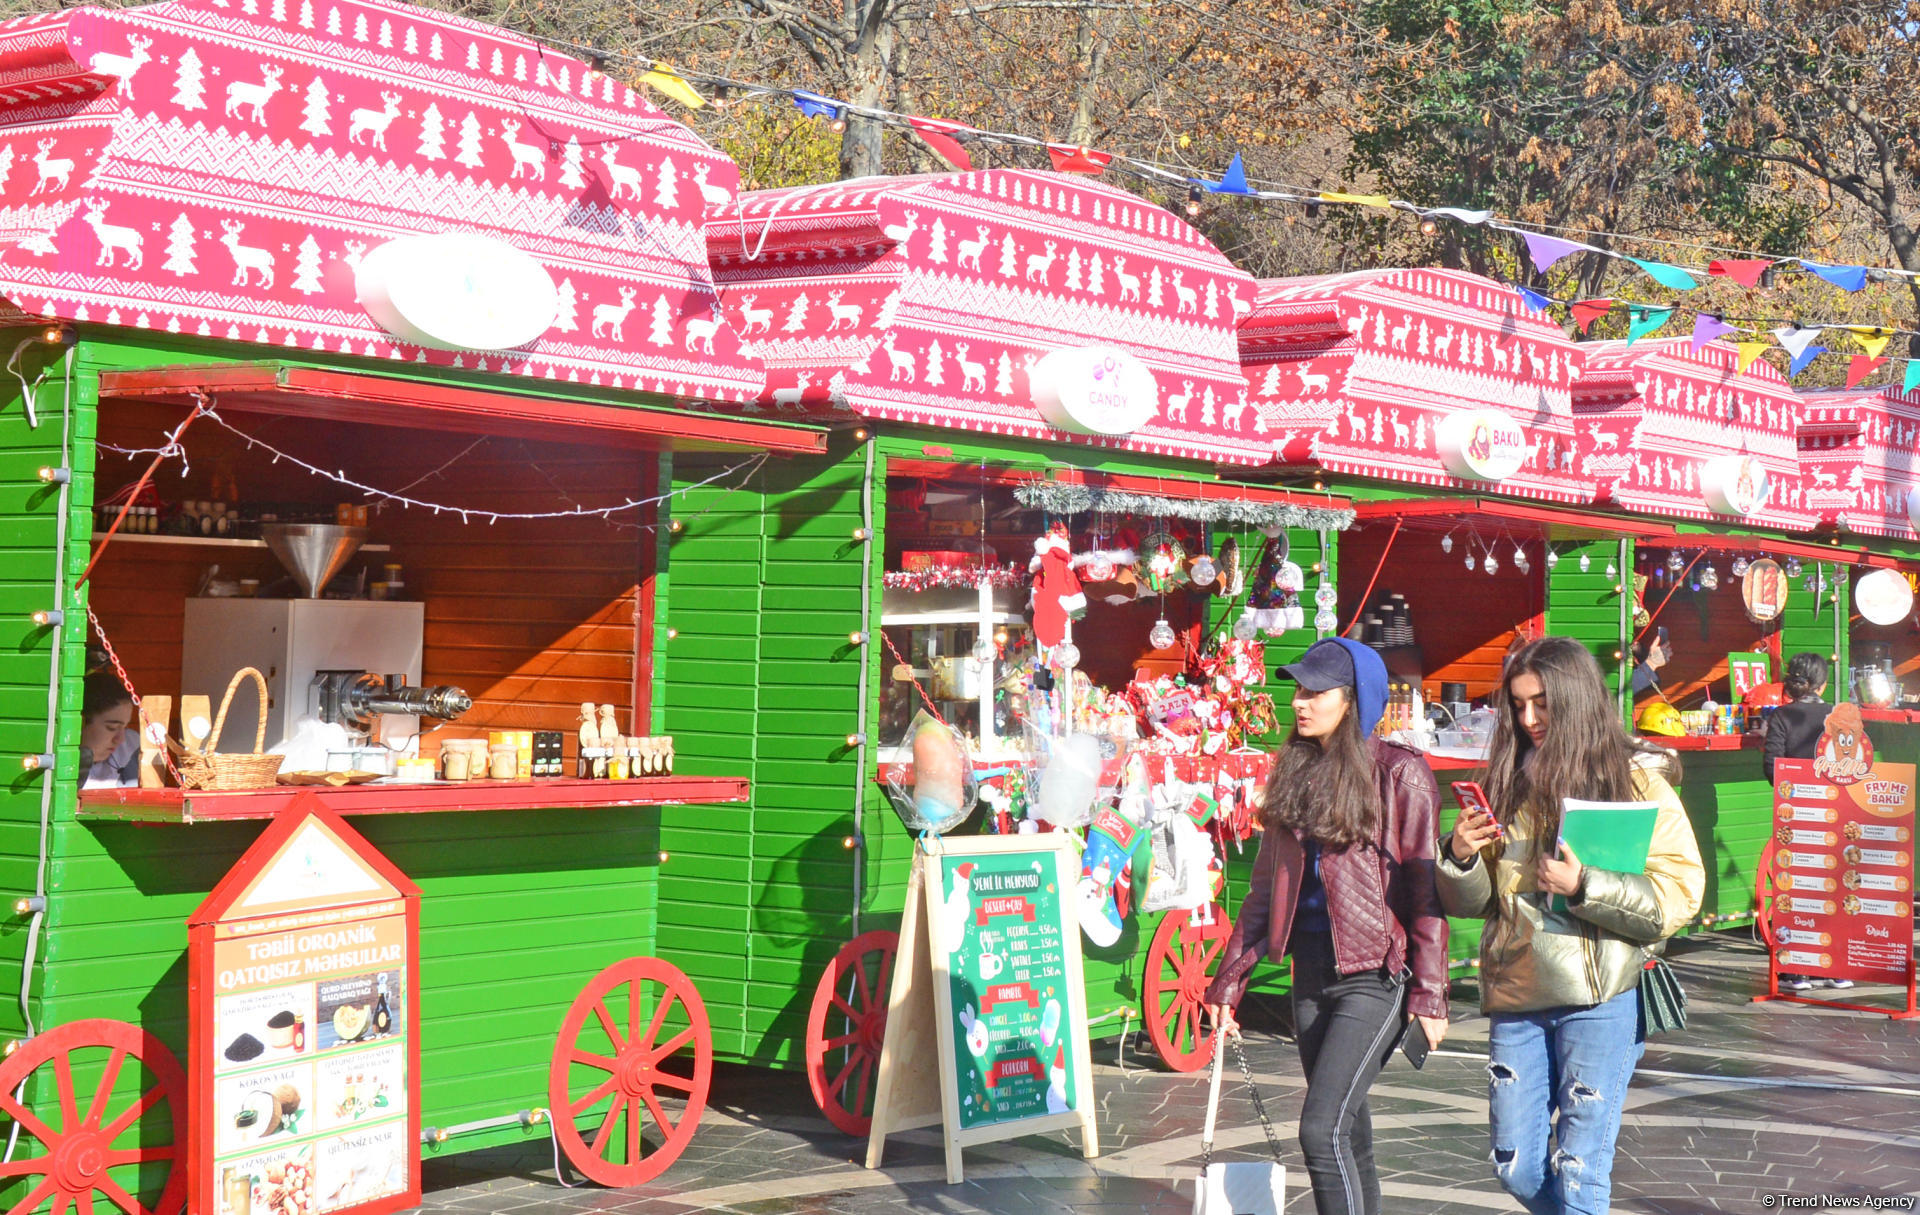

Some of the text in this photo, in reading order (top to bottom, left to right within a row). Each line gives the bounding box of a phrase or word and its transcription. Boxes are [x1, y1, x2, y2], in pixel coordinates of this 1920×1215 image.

[1089, 391, 1128, 408] CANDY
[1493, 430, 1520, 447] BAKU
[1865, 781, 1908, 794] FRY ME
[1871, 794, 1900, 805] BAKU
[248, 924, 376, 960] TƏBİİ ORQANİK
[219, 944, 401, 989] QATQISIZ MƏHSULLAR
